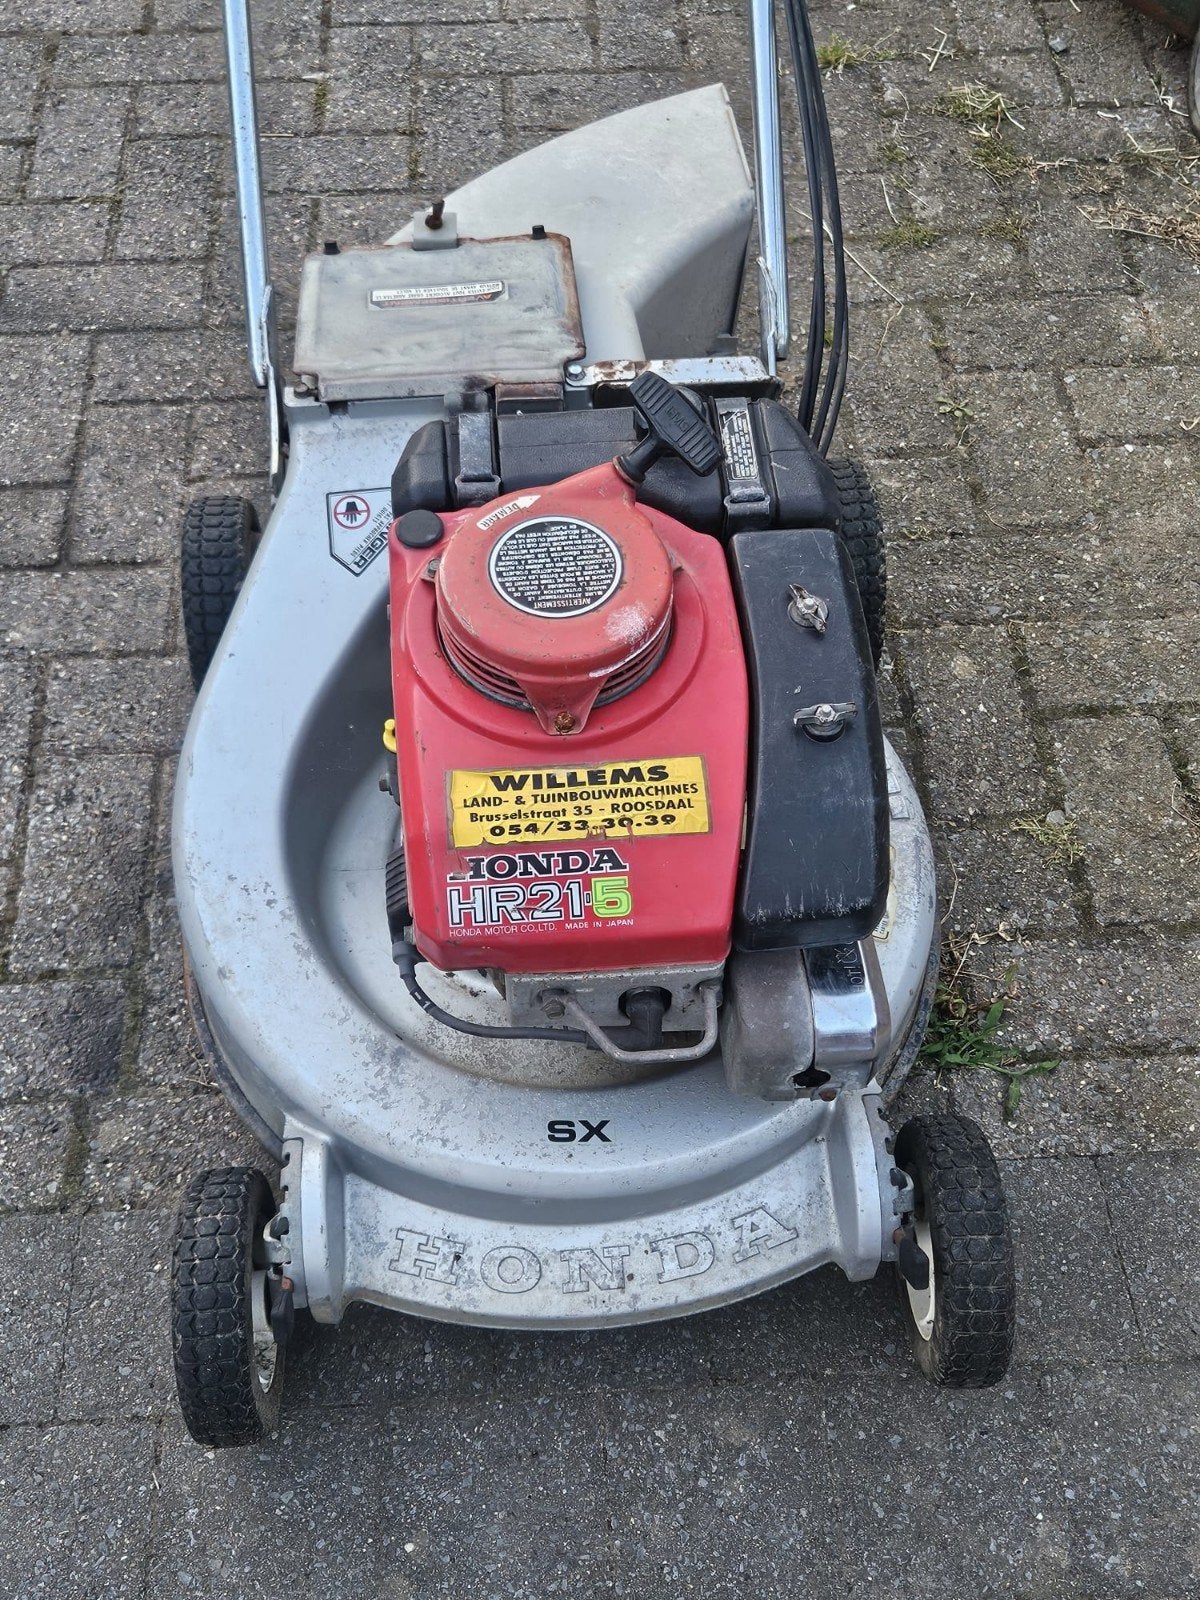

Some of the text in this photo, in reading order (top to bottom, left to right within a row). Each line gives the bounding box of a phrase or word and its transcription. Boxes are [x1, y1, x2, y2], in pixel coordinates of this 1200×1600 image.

[533, 597, 590, 608] AVERTISSEMENT
[537, 592, 582, 600] ATTENTIVEMENT
[490, 765, 669, 791] WILLEMS
[463, 783, 699, 809] LAND- & TUINBOUWMACHINES
[469, 807, 567, 823] Brusselstraat
[573, 805, 593, 816] 35
[611, 798, 694, 814] ROOSDAAL
[490, 815, 676, 837] 054/33.30.39
[448, 848, 629, 881] HONDA
[449, 927, 482, 938] HONDA
[484, 925, 518, 936] MOTOR
[565, 920, 589, 930] MADE
[593, 920, 602, 928] IN
[606, 918, 634, 927] JAPAN
[547, 1119, 611, 1143] SX
[388, 1207, 799, 1294] HONDA
